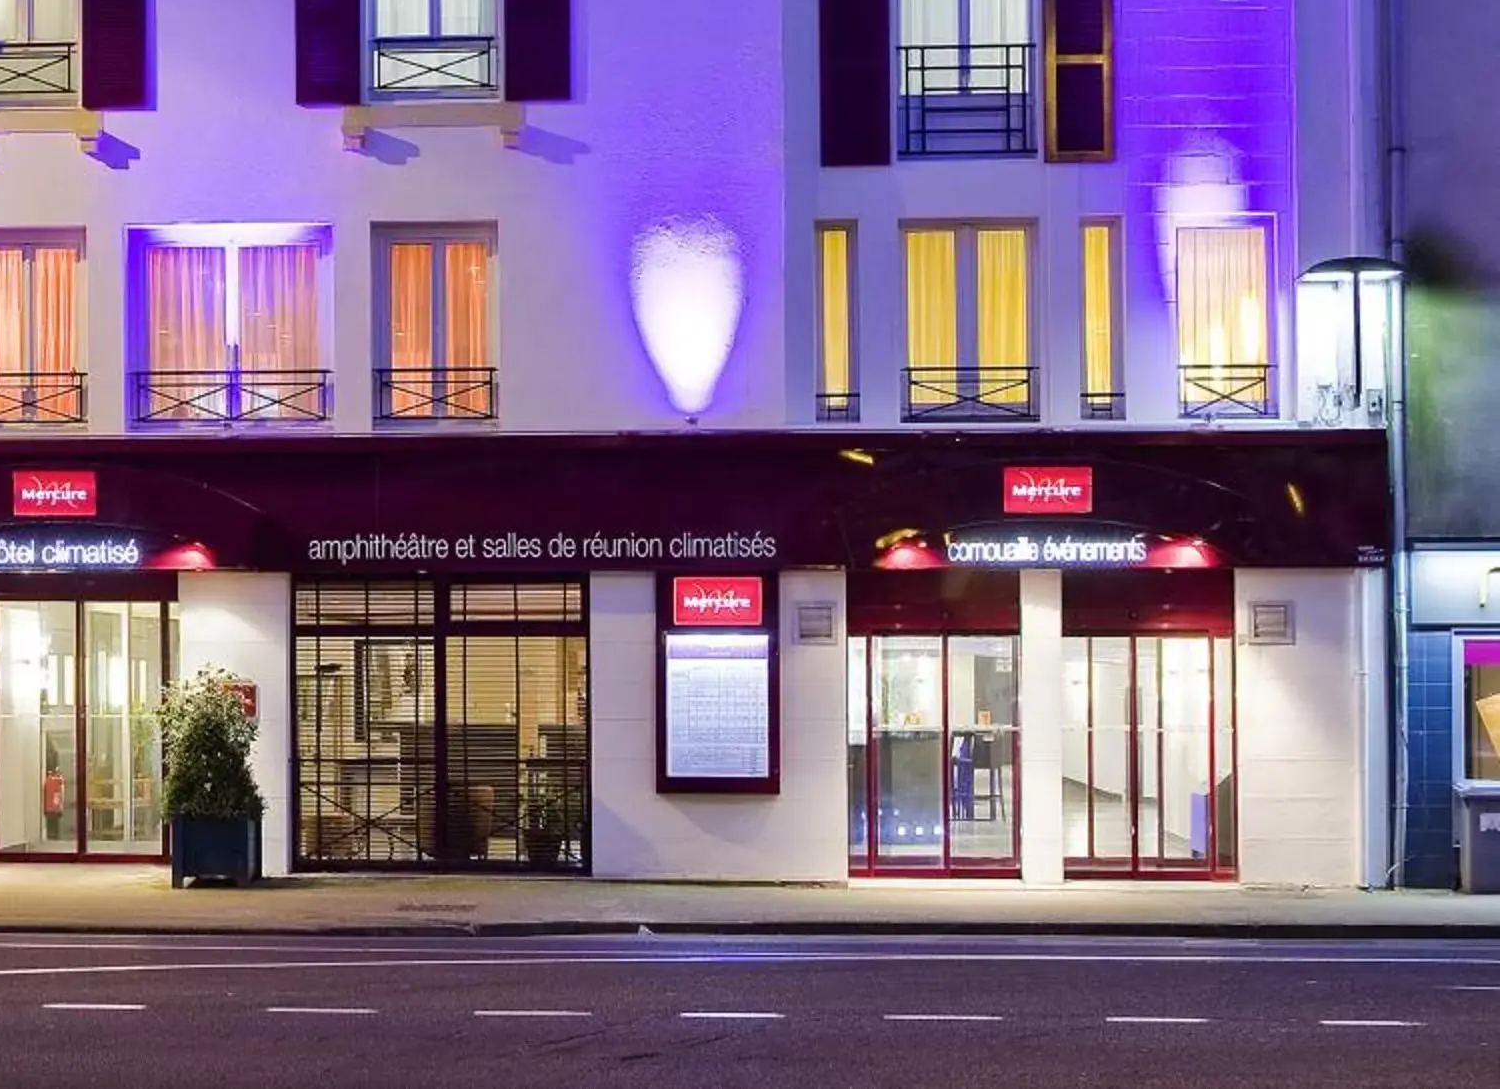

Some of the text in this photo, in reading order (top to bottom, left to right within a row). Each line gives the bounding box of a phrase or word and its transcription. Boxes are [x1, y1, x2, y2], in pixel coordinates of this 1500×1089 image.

[21, 488, 87, 500] Mercure
[1012, 484, 1082, 497] Mercure
[42, 538, 139, 564] climatisé
[308, 530, 778, 565] amphithéâtre et salles de réunion climatisés
[1043, 534, 1146, 562] événements
[683, 597, 751, 608] Mercure
